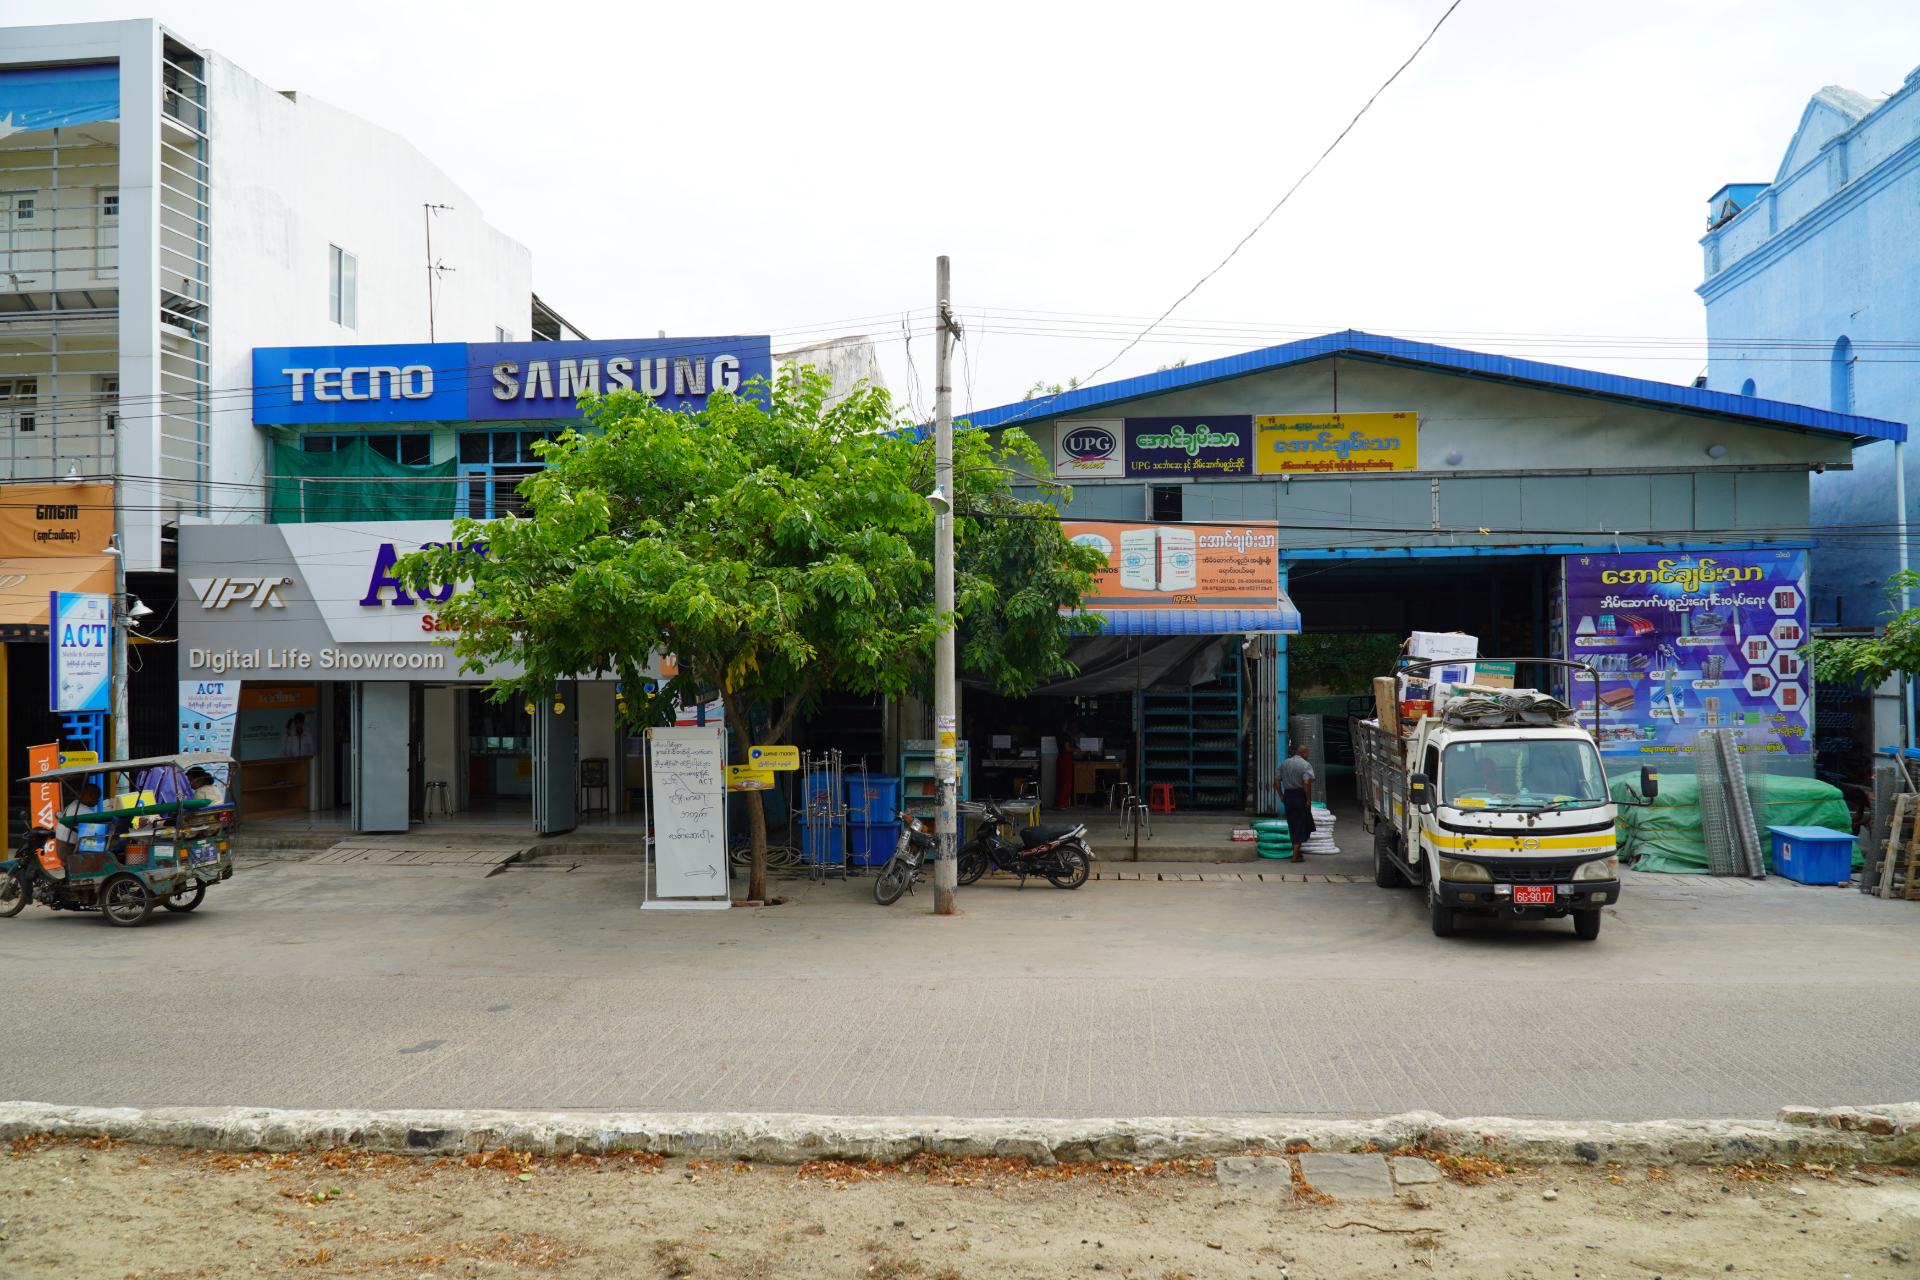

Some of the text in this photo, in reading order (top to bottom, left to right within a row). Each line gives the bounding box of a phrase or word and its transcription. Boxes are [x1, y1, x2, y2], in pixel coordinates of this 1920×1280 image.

[282, 365, 434, 402] TECNO
[492, 355, 742, 401] SAMSUNG
[1068, 437, 1110, 451] UPG
[1136, 424, 1240, 457] အောင်ချမ်းသာ
[1274, 431, 1400, 459] အောင်ချမ်းသာ
[1070, 460, 1105, 470] Paint
[1131, 461, 1150, 470] UPG
[1198, 529, 1275, 554] အောင်ချမ်းသာ
[1602, 558, 1763, 593] အောင်ချမ်းသာ
[61, 624, 106, 648] ACT
[189, 648, 445, 673] Digital Life Showroom
[1479, 663, 1511, 672] Hisense
[196, 683, 224, 695] ACT
[259, 691, 300, 703] realme
[1517, 892, 1552, 902] 6G-9017
